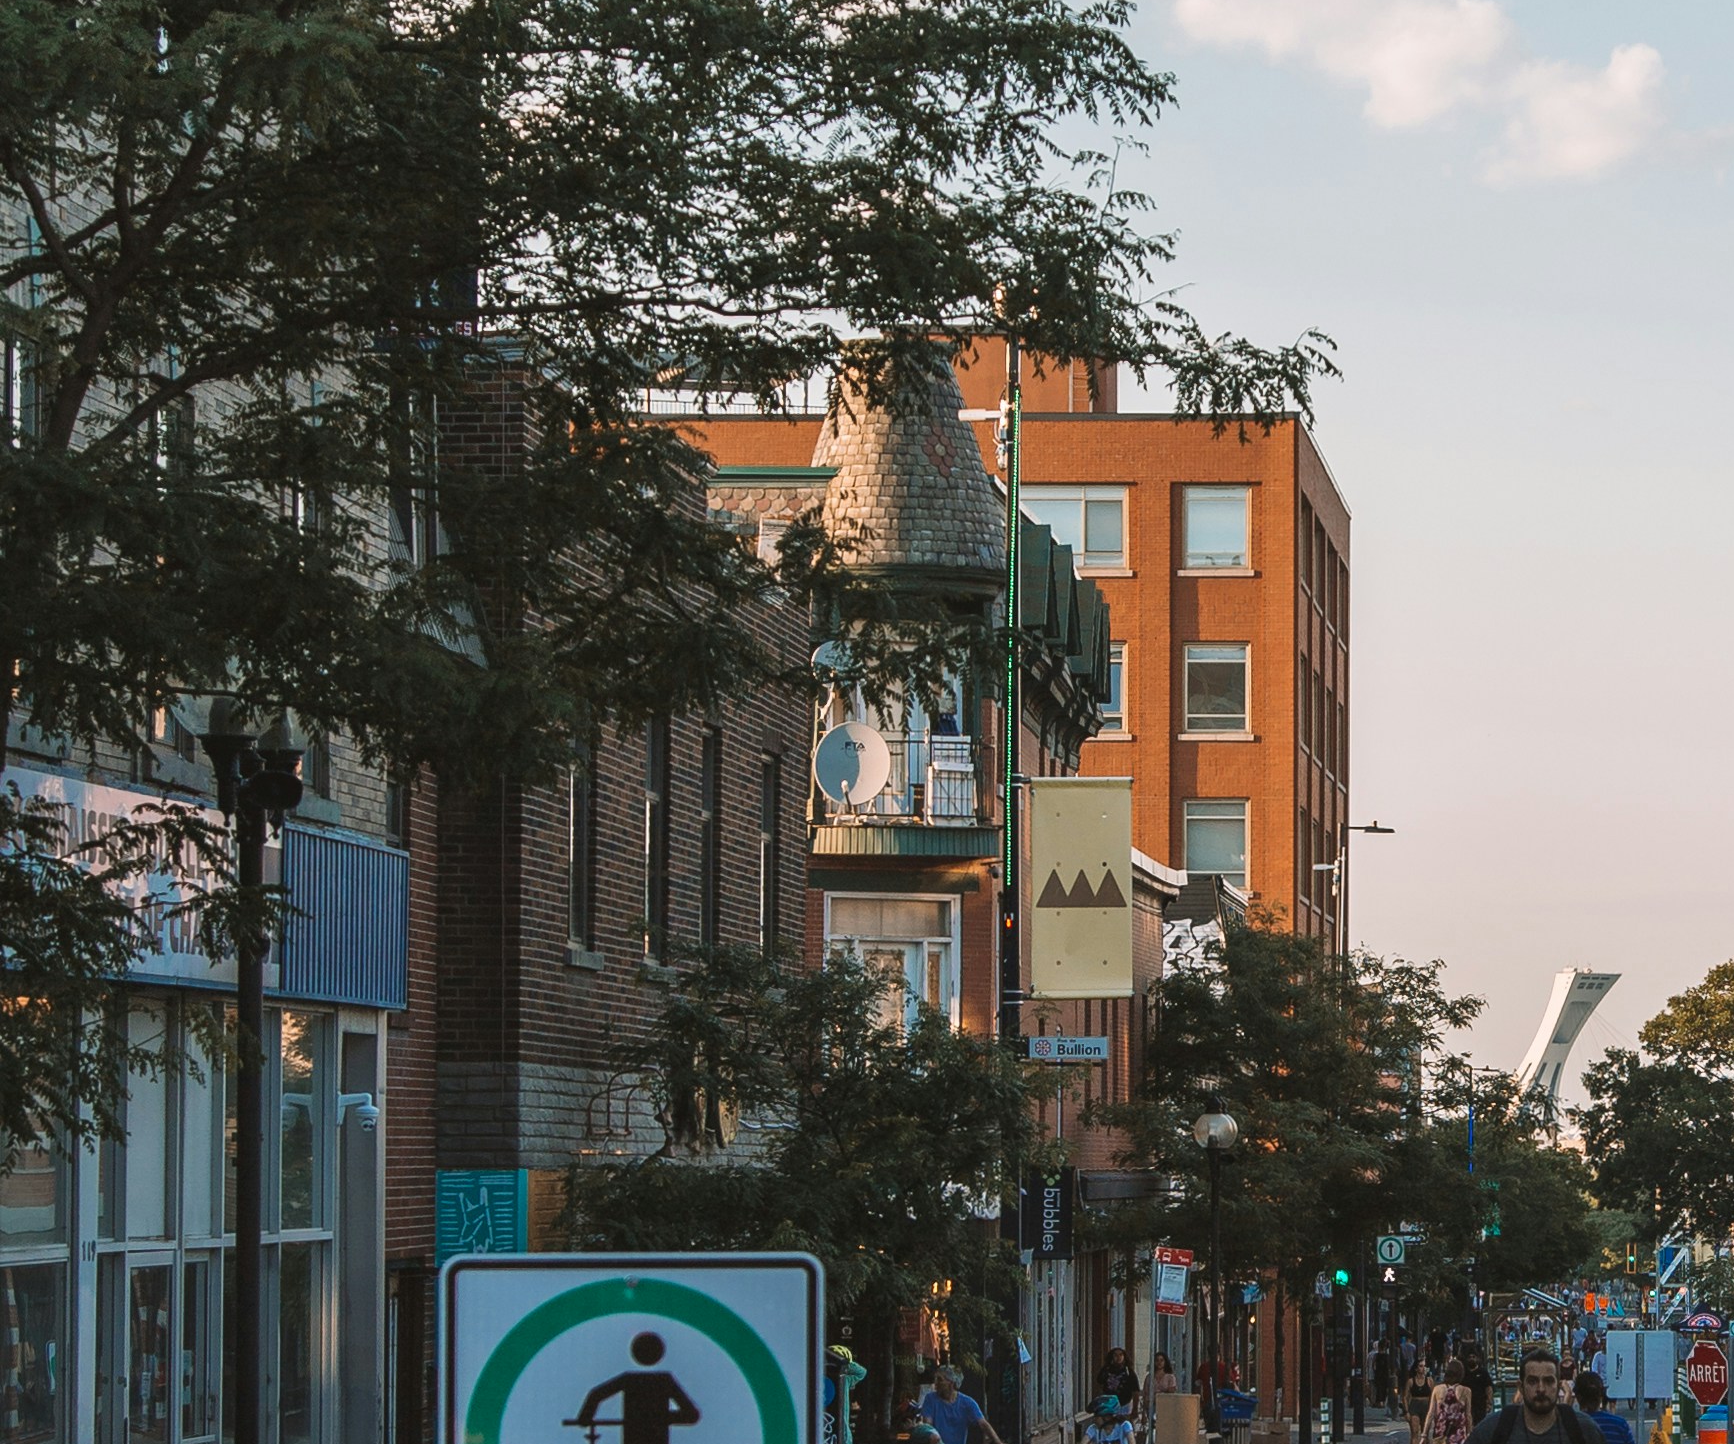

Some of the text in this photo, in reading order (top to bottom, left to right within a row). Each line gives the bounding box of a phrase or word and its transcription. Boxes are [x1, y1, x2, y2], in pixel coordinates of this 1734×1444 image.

[1057, 1044, 1101, 1055] Bullion
[1043, 1188, 1061, 1252] bubbles
[82, 1240, 96, 1262] 119
[1689, 1362, 1725, 1383] ARRÊT
